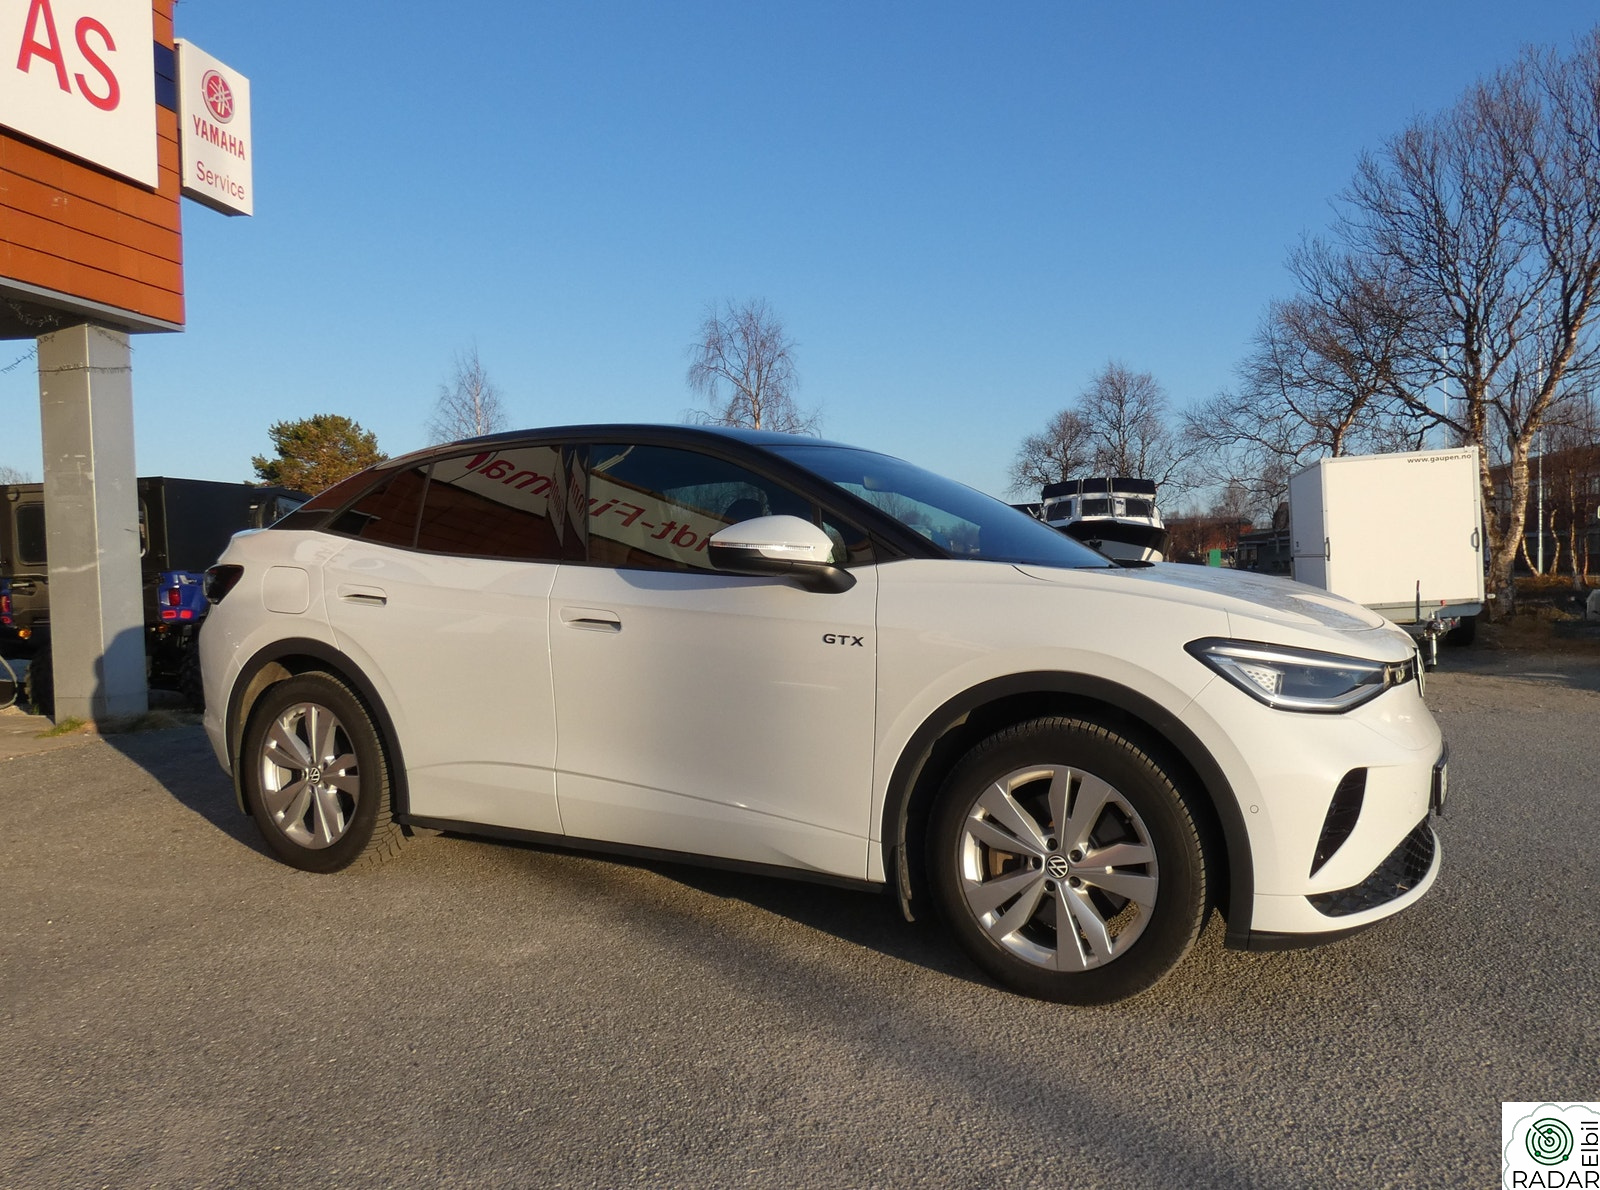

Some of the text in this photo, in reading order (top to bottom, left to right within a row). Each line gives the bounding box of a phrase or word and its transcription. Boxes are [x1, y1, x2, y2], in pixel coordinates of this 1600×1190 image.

[16, 0, 120, 111] AS
[192, 114, 246, 160] YAMAHA
[196, 160, 245, 200] Service
[1407, 454, 1472, 464] www.gaupen.no
[822, 633, 864, 647] GTX
